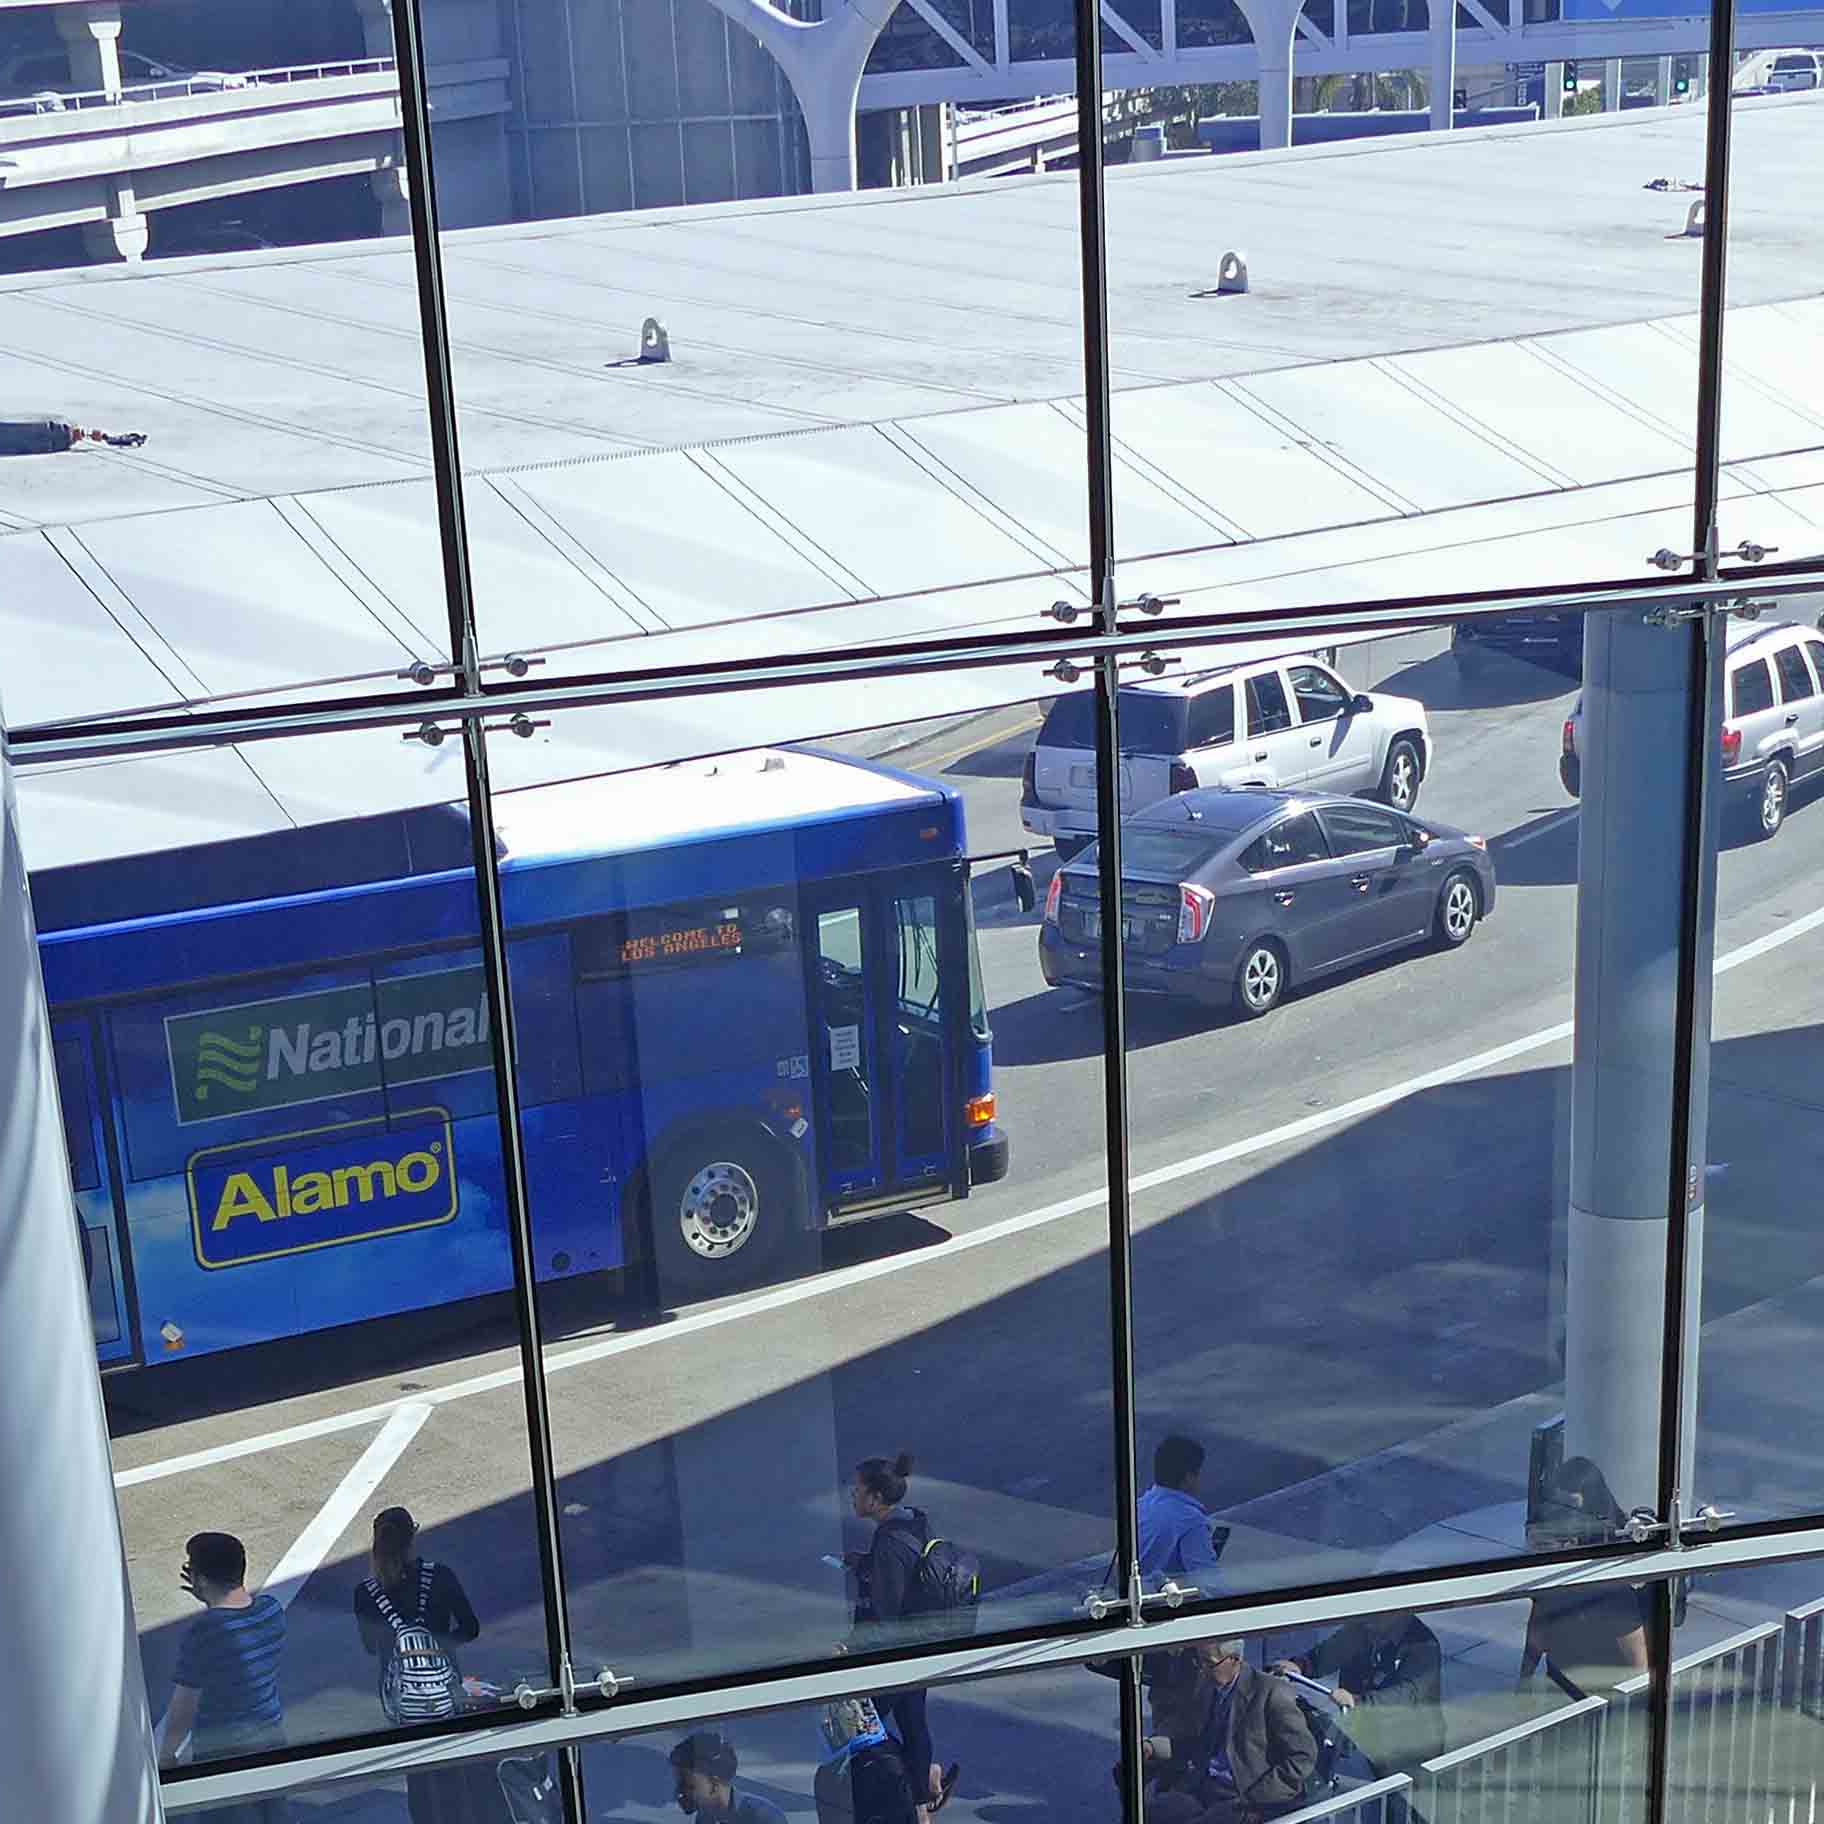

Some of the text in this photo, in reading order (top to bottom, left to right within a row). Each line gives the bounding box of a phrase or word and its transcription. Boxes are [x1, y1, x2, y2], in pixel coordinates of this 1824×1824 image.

[624, 923, 737, 949] WELCOME TO
[622, 946, 656, 961] LOS
[266, 992, 490, 1081] National
